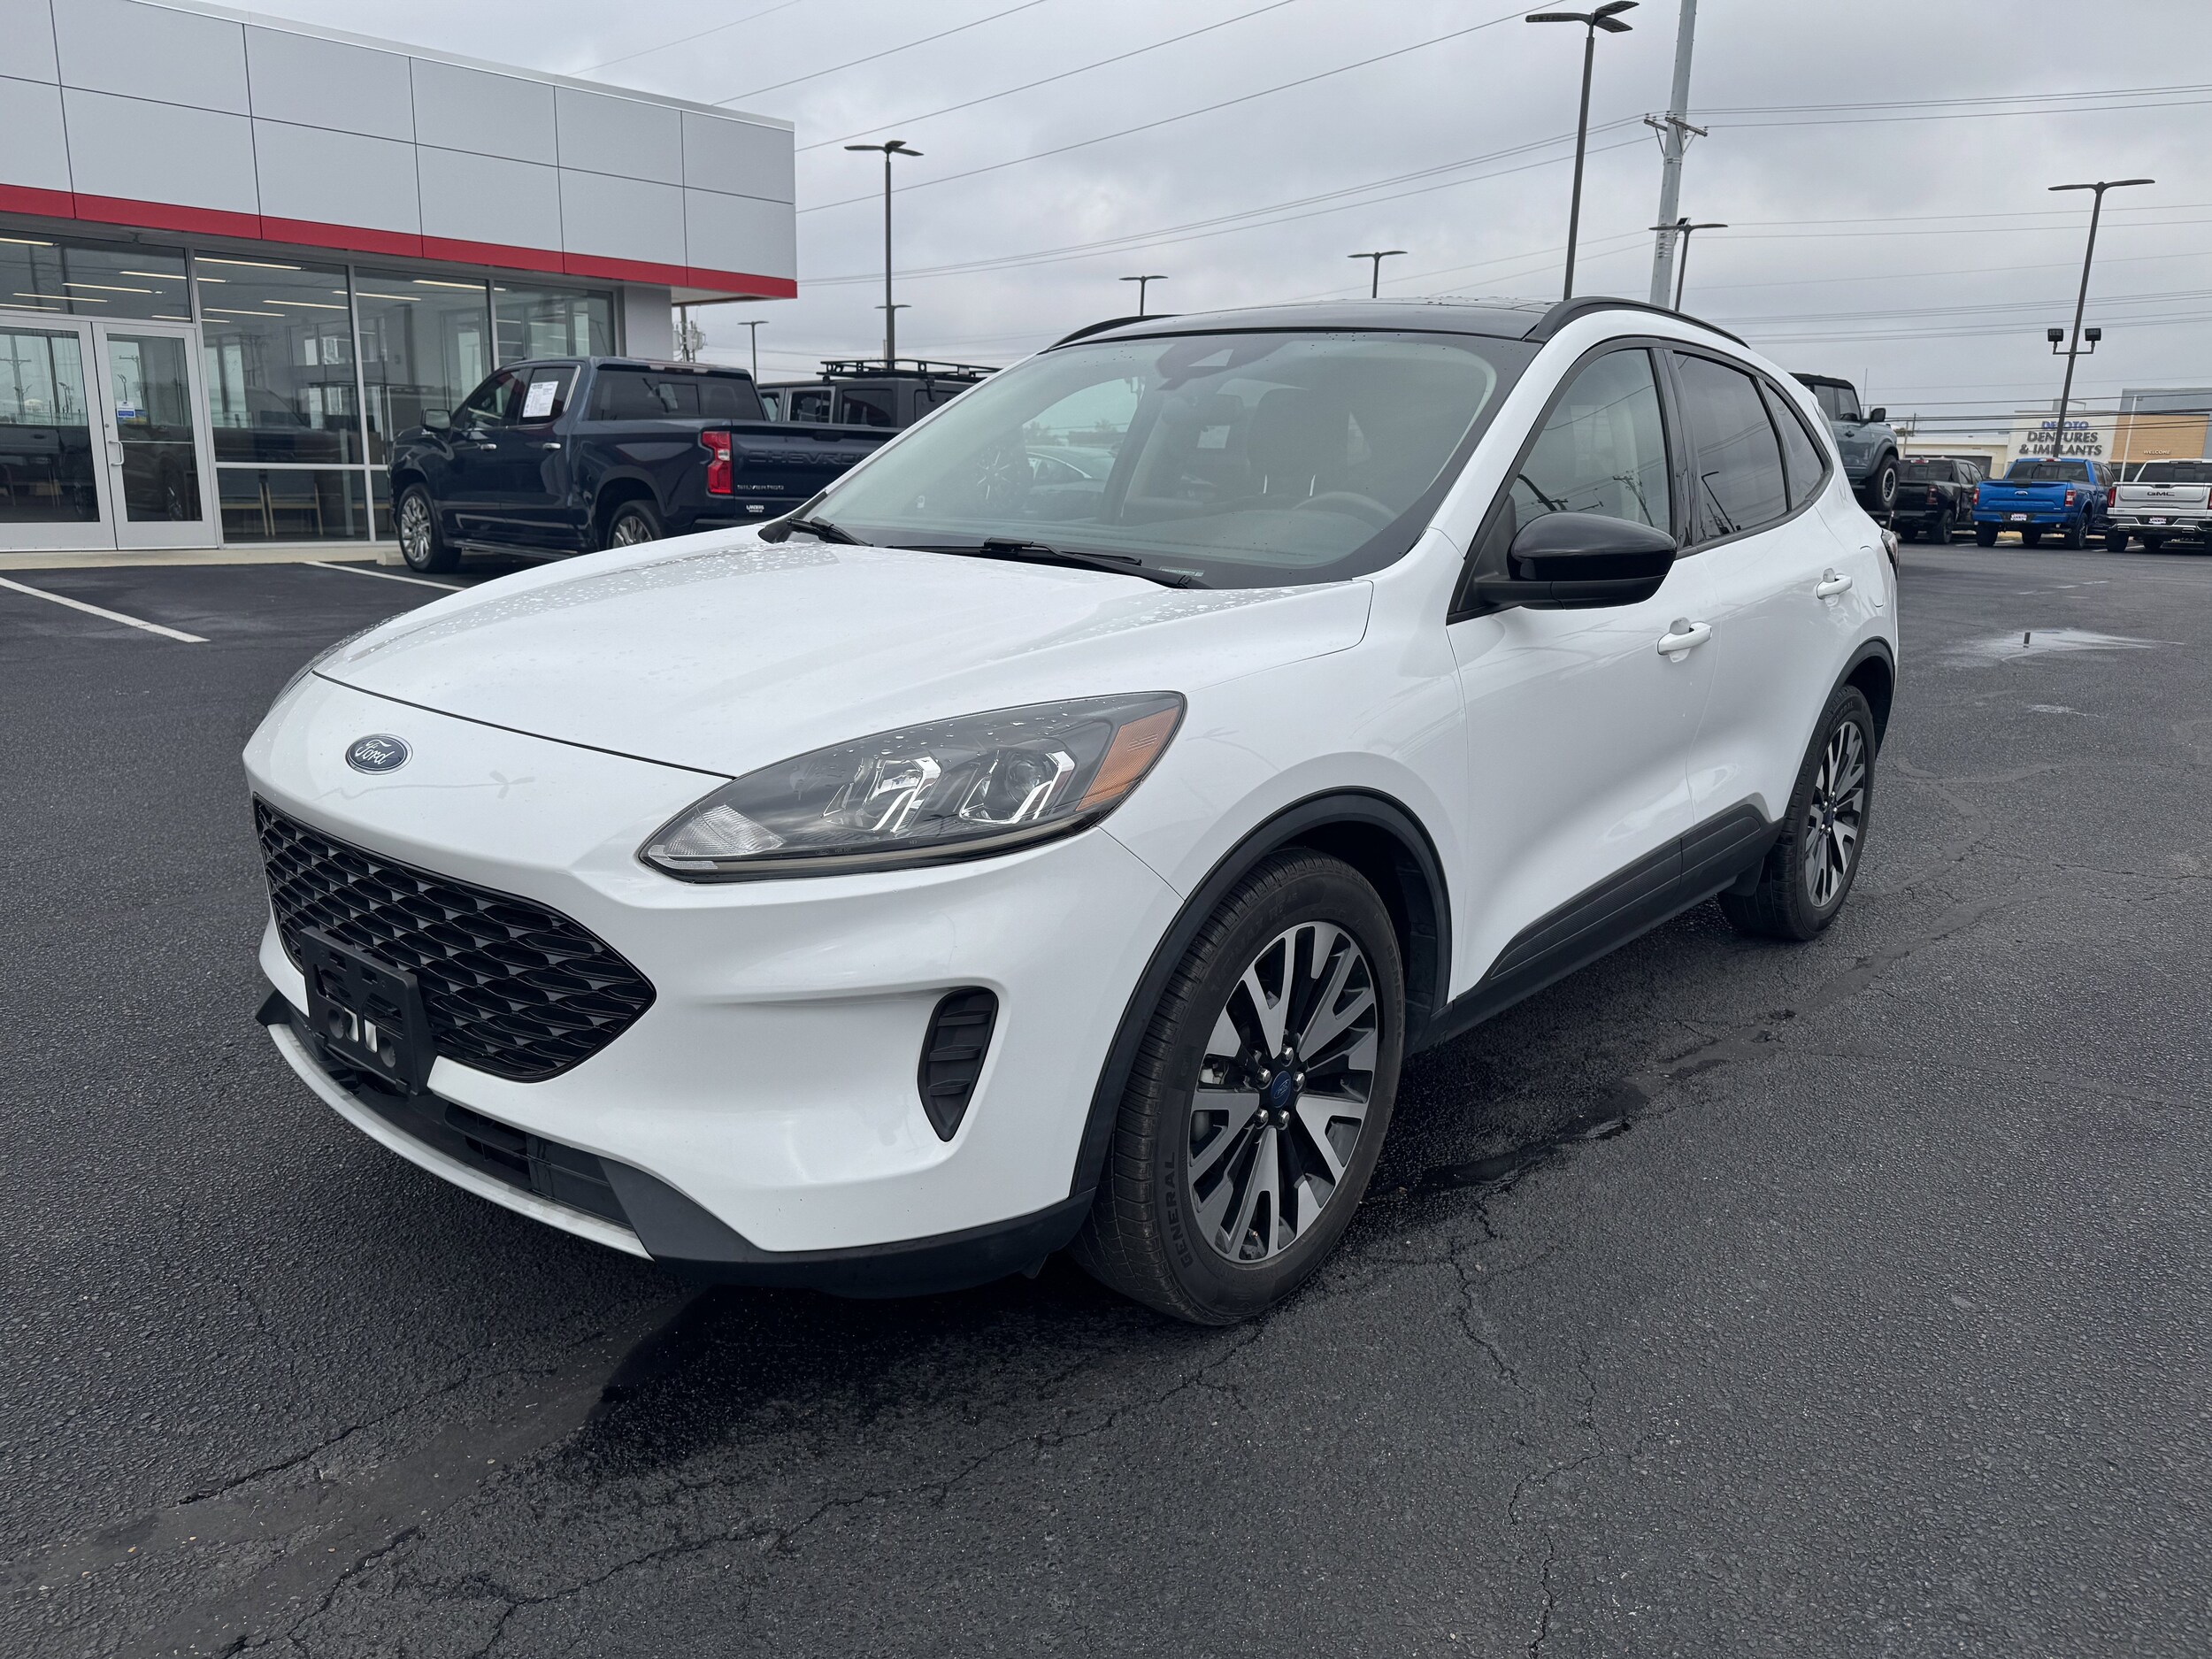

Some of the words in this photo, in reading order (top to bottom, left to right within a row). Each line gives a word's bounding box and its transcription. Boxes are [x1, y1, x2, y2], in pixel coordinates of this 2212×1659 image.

[2041, 420, 2089, 430] DEOTO
[2027, 431, 2099, 443] DENURES
[2019, 444, 2030, 455] &
[2034, 444, 2102, 456] IMLANTS
[355, 739, 396, 764] Ford
[1164, 1151, 1194, 1269] GENERAL
